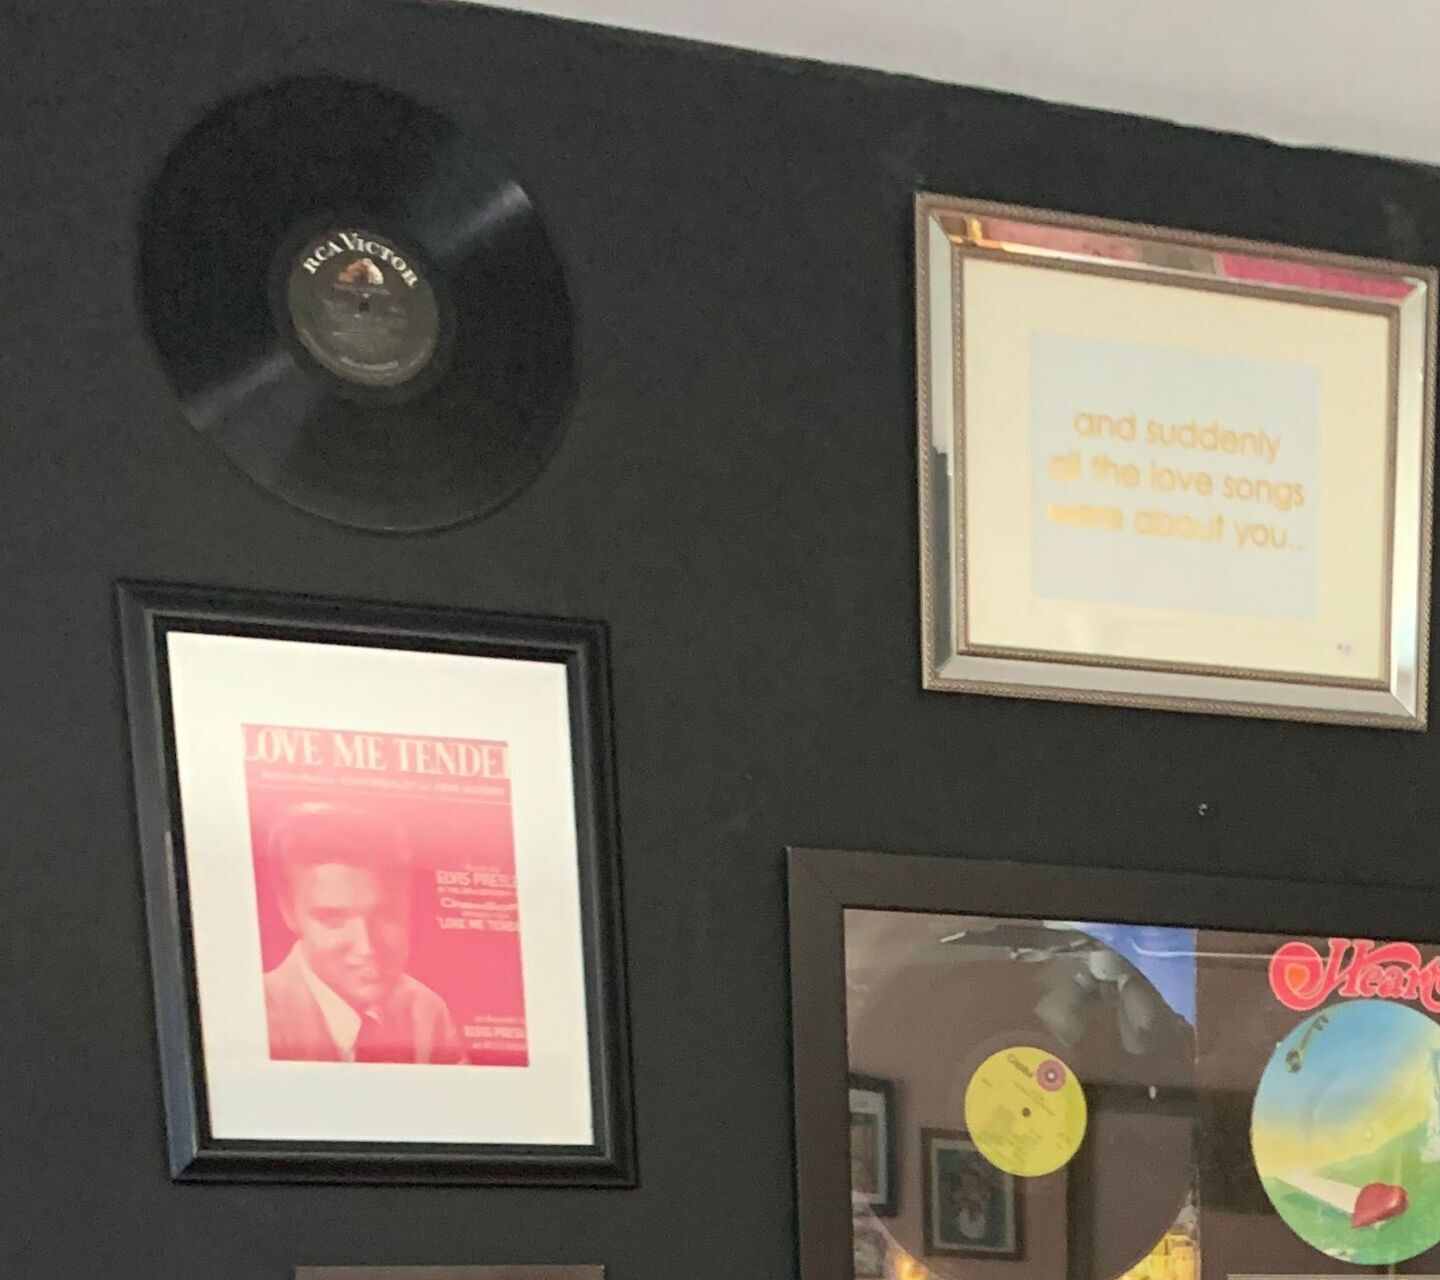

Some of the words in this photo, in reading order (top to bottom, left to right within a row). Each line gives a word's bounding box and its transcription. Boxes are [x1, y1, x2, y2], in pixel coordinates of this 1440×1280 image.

[303, 240, 345, 275] RCA
[338, 233, 418, 288] VICTOR
[1073, 410, 1136, 443] and
[1145, 418, 1282, 466] suddenly
[1091, 453, 1142, 488] the
[1148, 458, 1214, 497] love
[1222, 473, 1306, 512] songs
[1133, 509, 1225, 542] about
[242, 727, 322, 766] LOVE
[332, 732, 387, 771] ME
